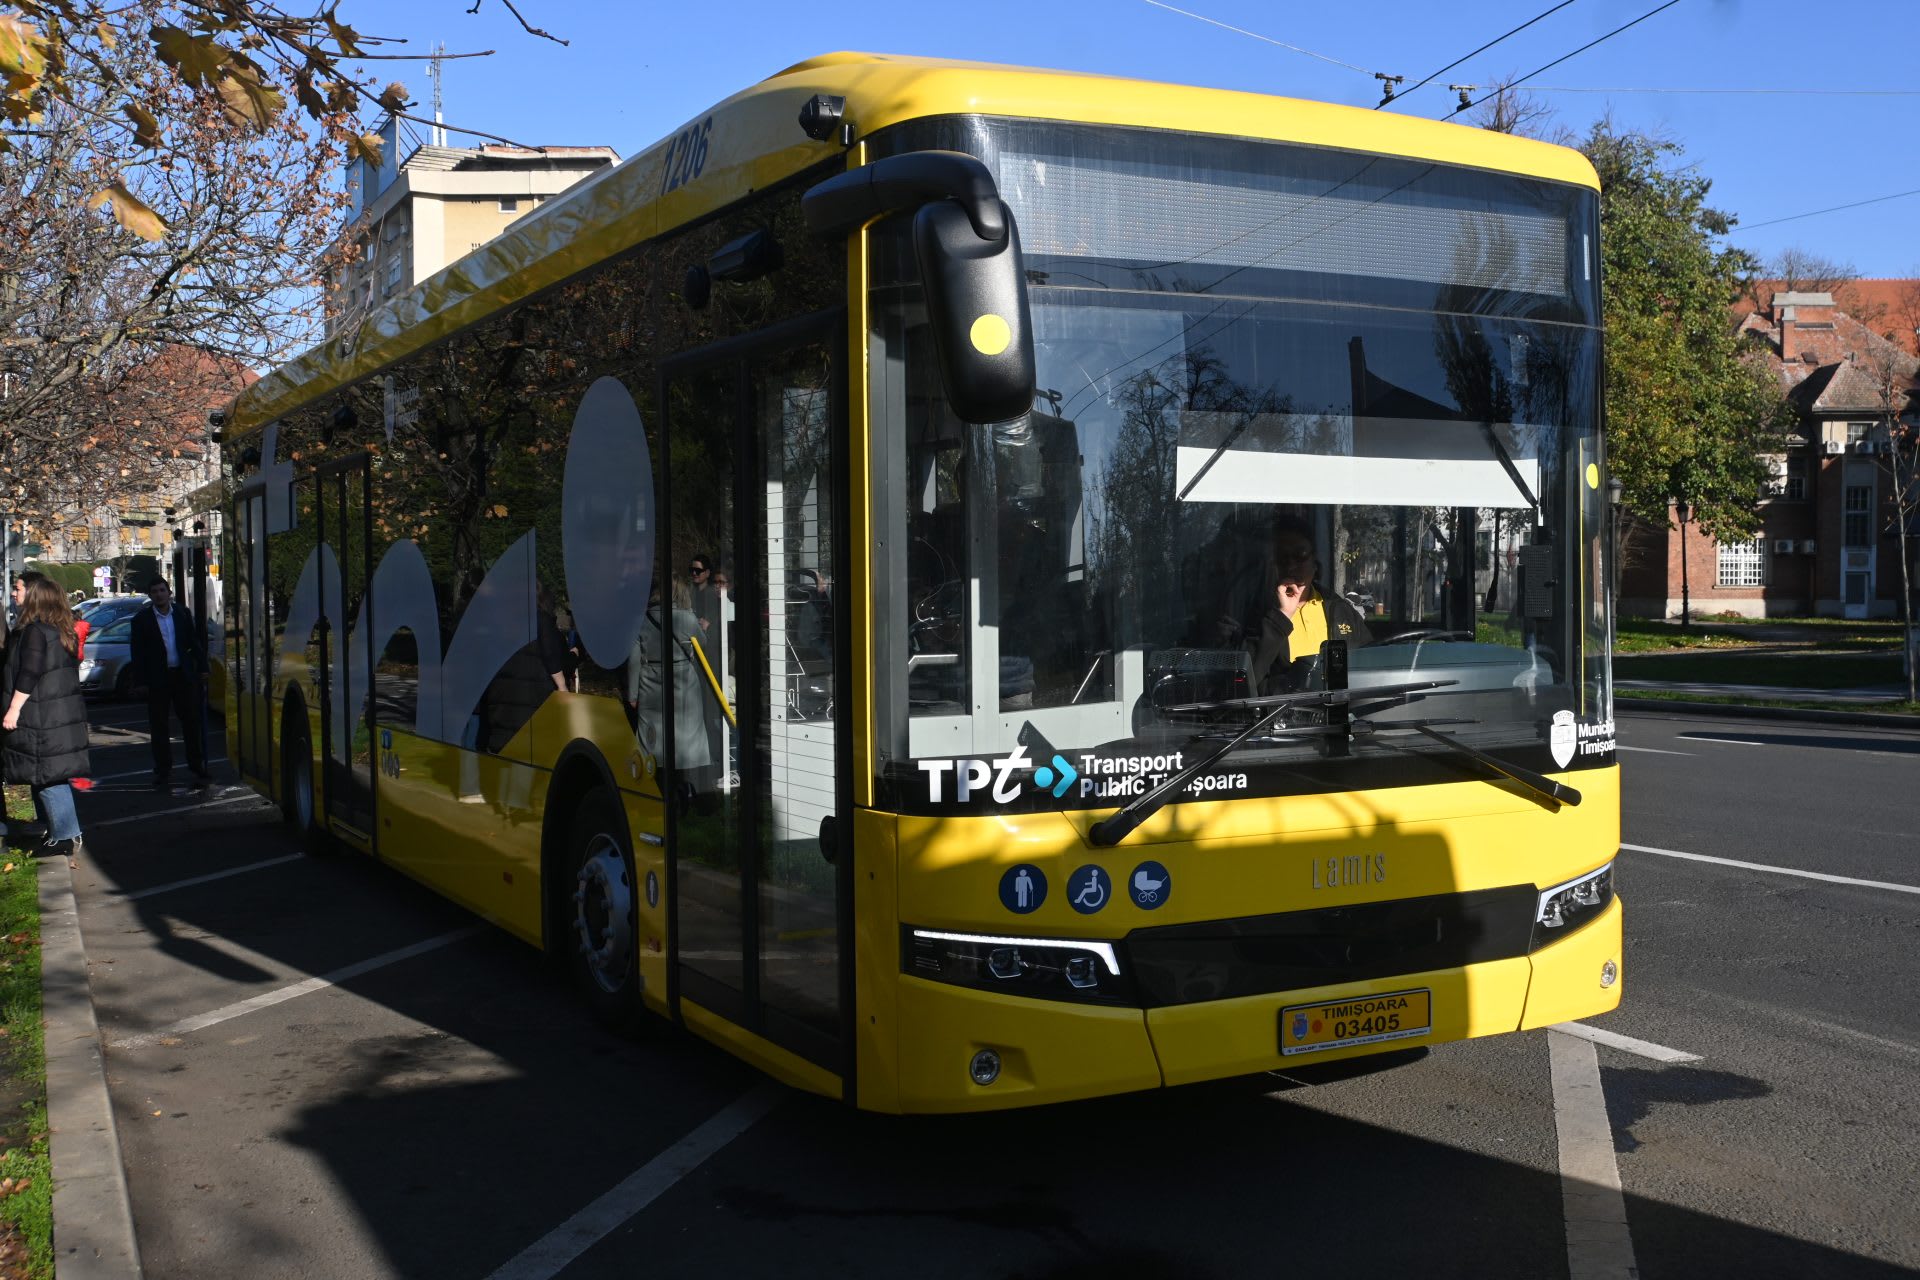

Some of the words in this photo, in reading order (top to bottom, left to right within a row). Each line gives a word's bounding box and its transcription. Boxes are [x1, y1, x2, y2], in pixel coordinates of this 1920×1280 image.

[661, 116, 713, 197] 1206
[1080, 751, 1183, 777] Transport
[1080, 775, 1145, 798] Public
[1334, 1013, 1400, 1039] 03405
